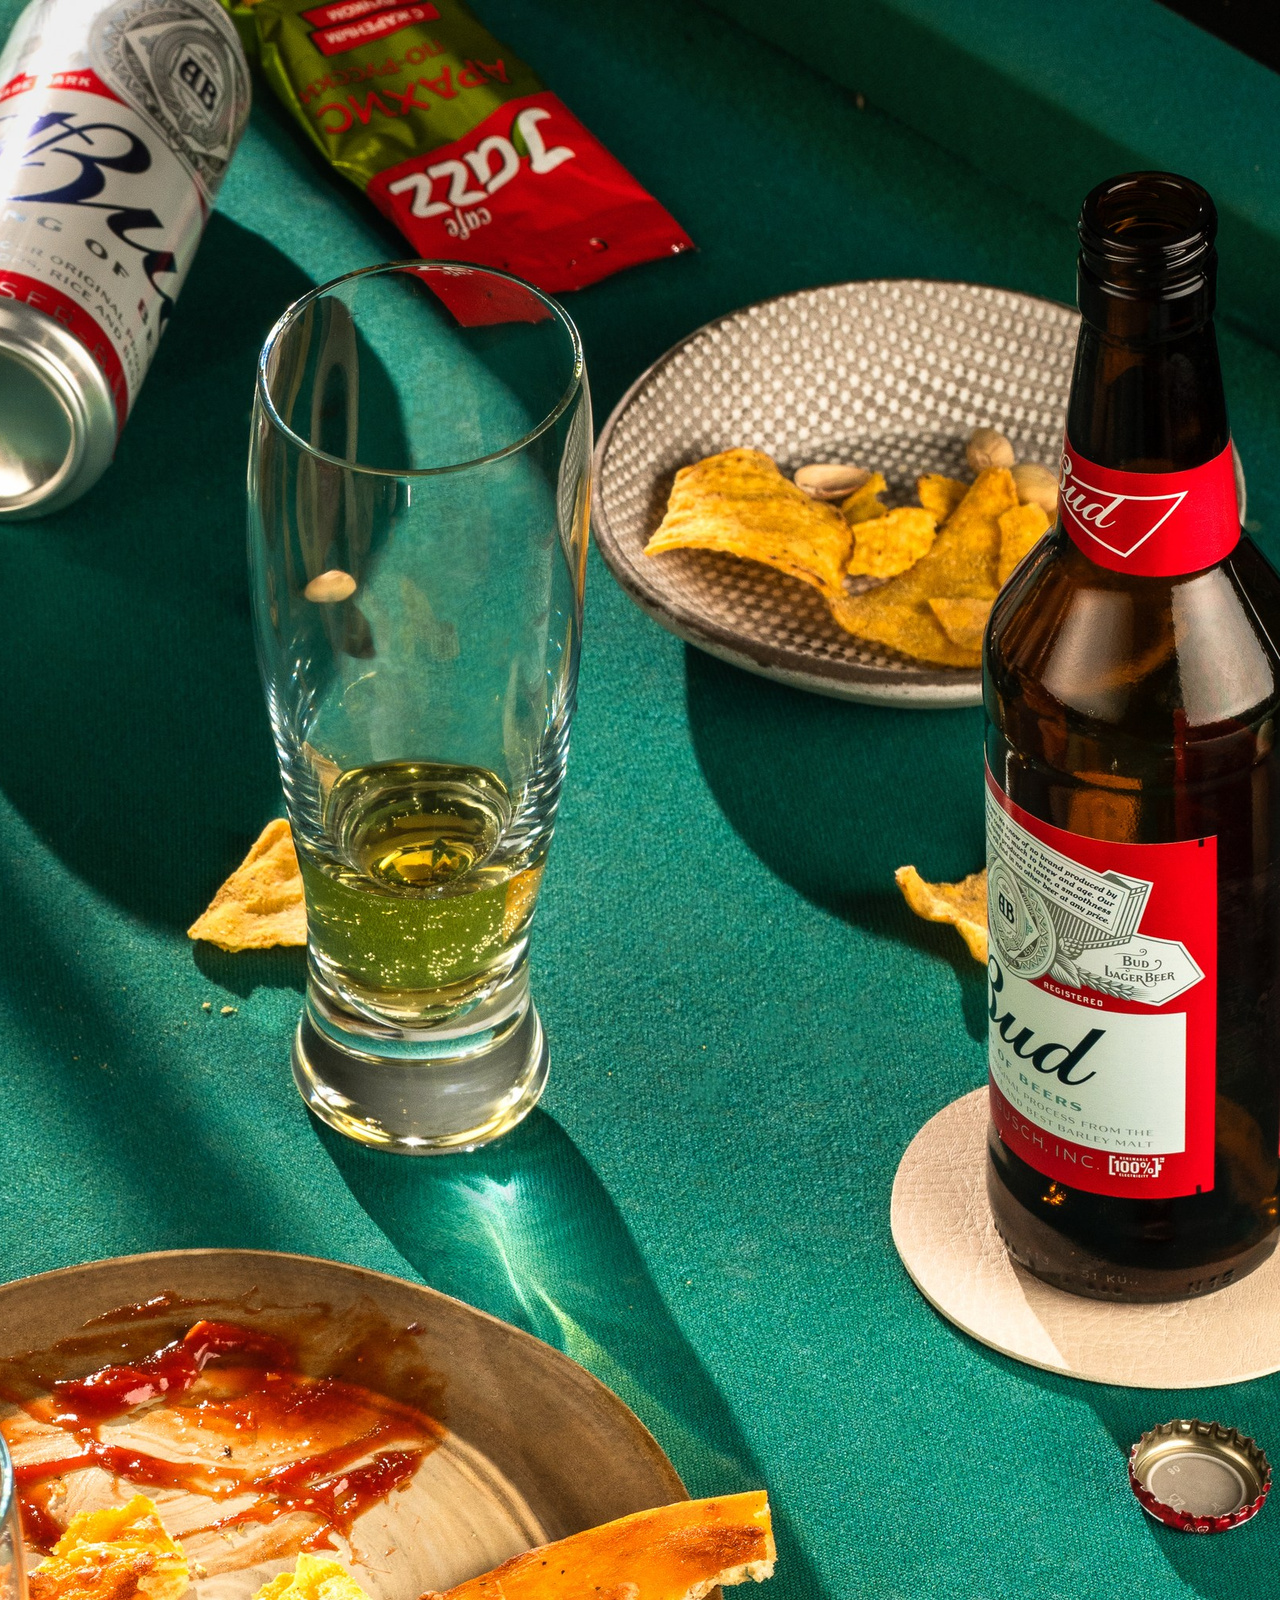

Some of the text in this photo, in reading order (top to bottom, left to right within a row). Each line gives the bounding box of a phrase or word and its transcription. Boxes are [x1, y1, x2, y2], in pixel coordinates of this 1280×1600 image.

[298, 40, 445, 103] ПО-РУССКИ
[317, 59, 509, 133] АРАХИС
[389, 108, 575, 217] Jazz
[444, 207, 492, 239] cafe
[85, 238, 130, 279] OF
[50, 255, 126, 328] ORIGINAL
[50, 269, 92, 302] RICE
[95, 304, 123, 340] AND
[1001, 837, 1028, 865] produces
[1033, 866, 1054, 886] taste,
[1060, 886, 1112, 916] smoothness
[1011, 839, 1028, 857] much
[1029, 854, 1038, 864] to
[1038, 860, 1059, 878] brew
[1058, 875, 1076, 889] and
[1097, 895, 1116, 908] Our
[1015, 862, 1024, 871] no
[1023, 869, 1043, 886] other
[1042, 882, 1060, 897] beer
[1059, 894, 1069, 904] at
[1069, 899, 1088, 914] any
[1087, 909, 1110, 925] price.
[1021, 839, 1030, 849] of
[1029, 846, 1039, 857] no
[1040, 850, 1064, 872] brand
[1065, 870, 1106, 894] produced
[1106, 889, 1119, 901] by
[988, 954, 1107, 1086] Bud
[1043, 981, 1104, 1008] REGISTERED
[997, 1048, 1012, 1069] OF
[1019, 1073, 1083, 1112] BEERS
[1023, 1093, 1154, 1138] PROCESS FROM THE
[1026, 1106, 1054, 1127] BEST
[1057, 1124, 1111, 1146] BARLEY
[1115, 1140, 1154, 1149] MALT
[1055, 1144, 1101, 1171] INC.
